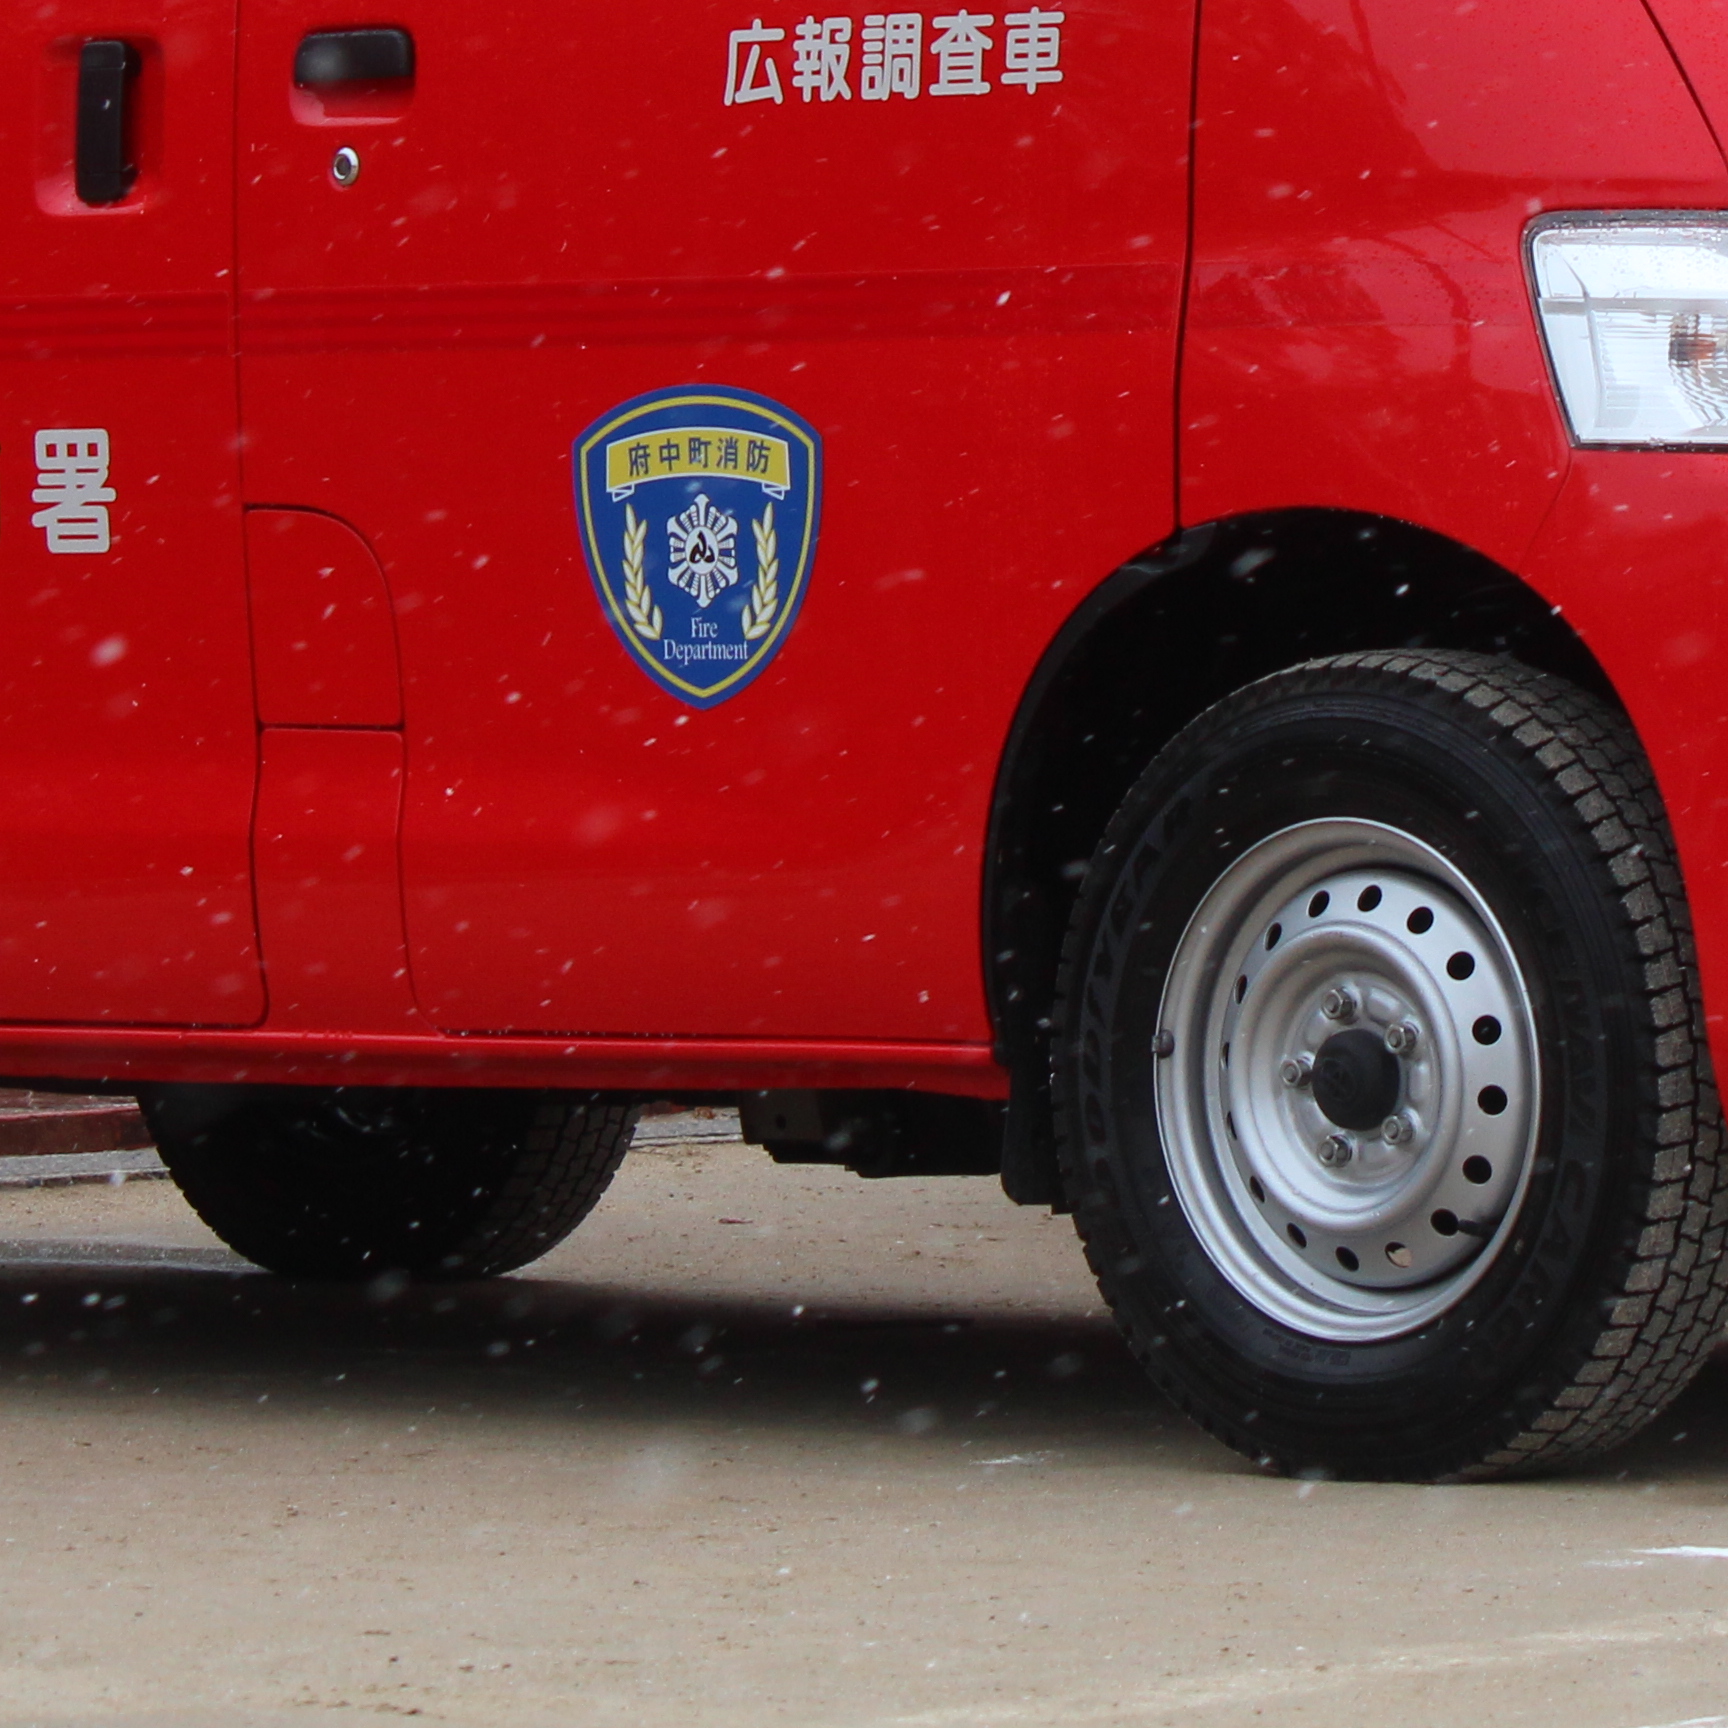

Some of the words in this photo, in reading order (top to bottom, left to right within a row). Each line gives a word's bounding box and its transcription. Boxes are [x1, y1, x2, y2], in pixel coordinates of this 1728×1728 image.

[722, 6, 1066, 106] 広報調査車
[627, 435, 771, 478] 府中町消防
[690, 616, 719, 639] Fire
[662, 638, 750, 666] Department
